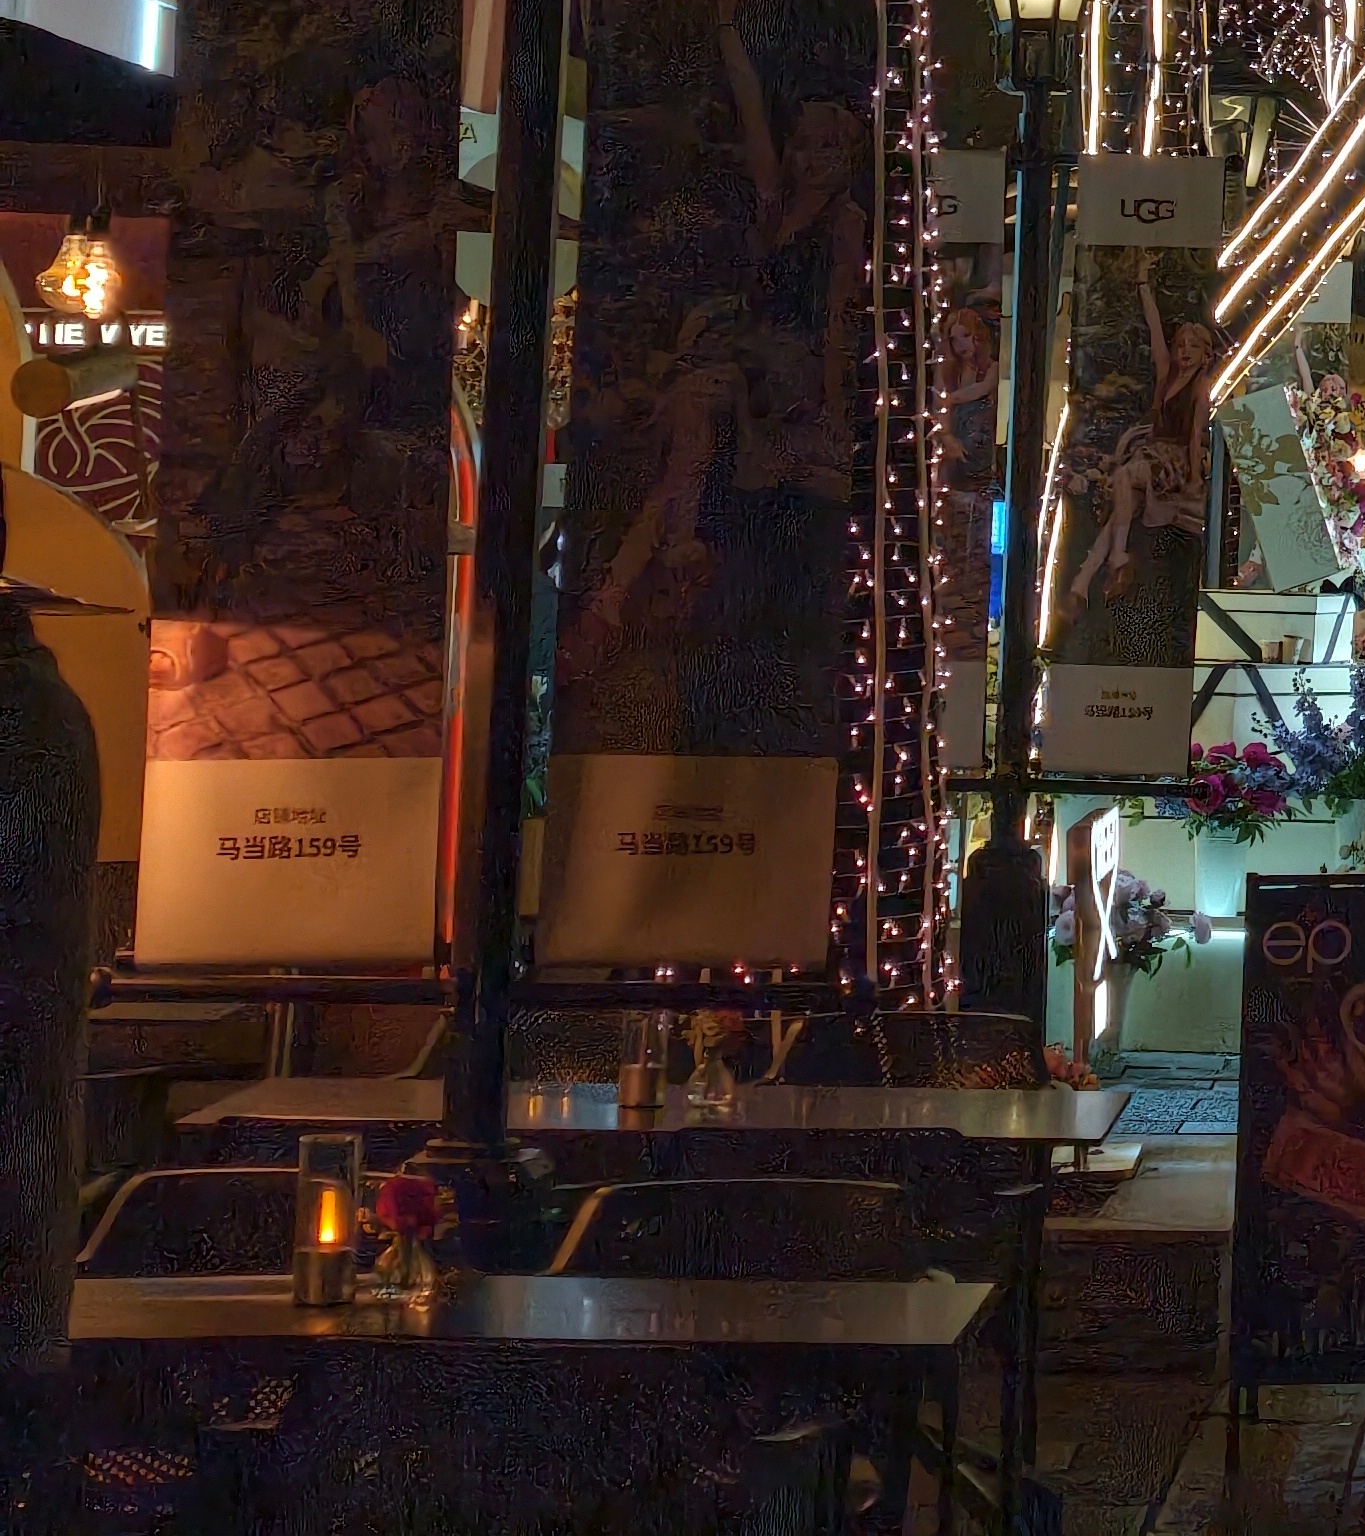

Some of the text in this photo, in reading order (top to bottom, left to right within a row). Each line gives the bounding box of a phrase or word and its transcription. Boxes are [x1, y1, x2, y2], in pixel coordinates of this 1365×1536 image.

[1120, 198, 1176, 224] UGG
[216, 834, 362, 861] 马当路159号
